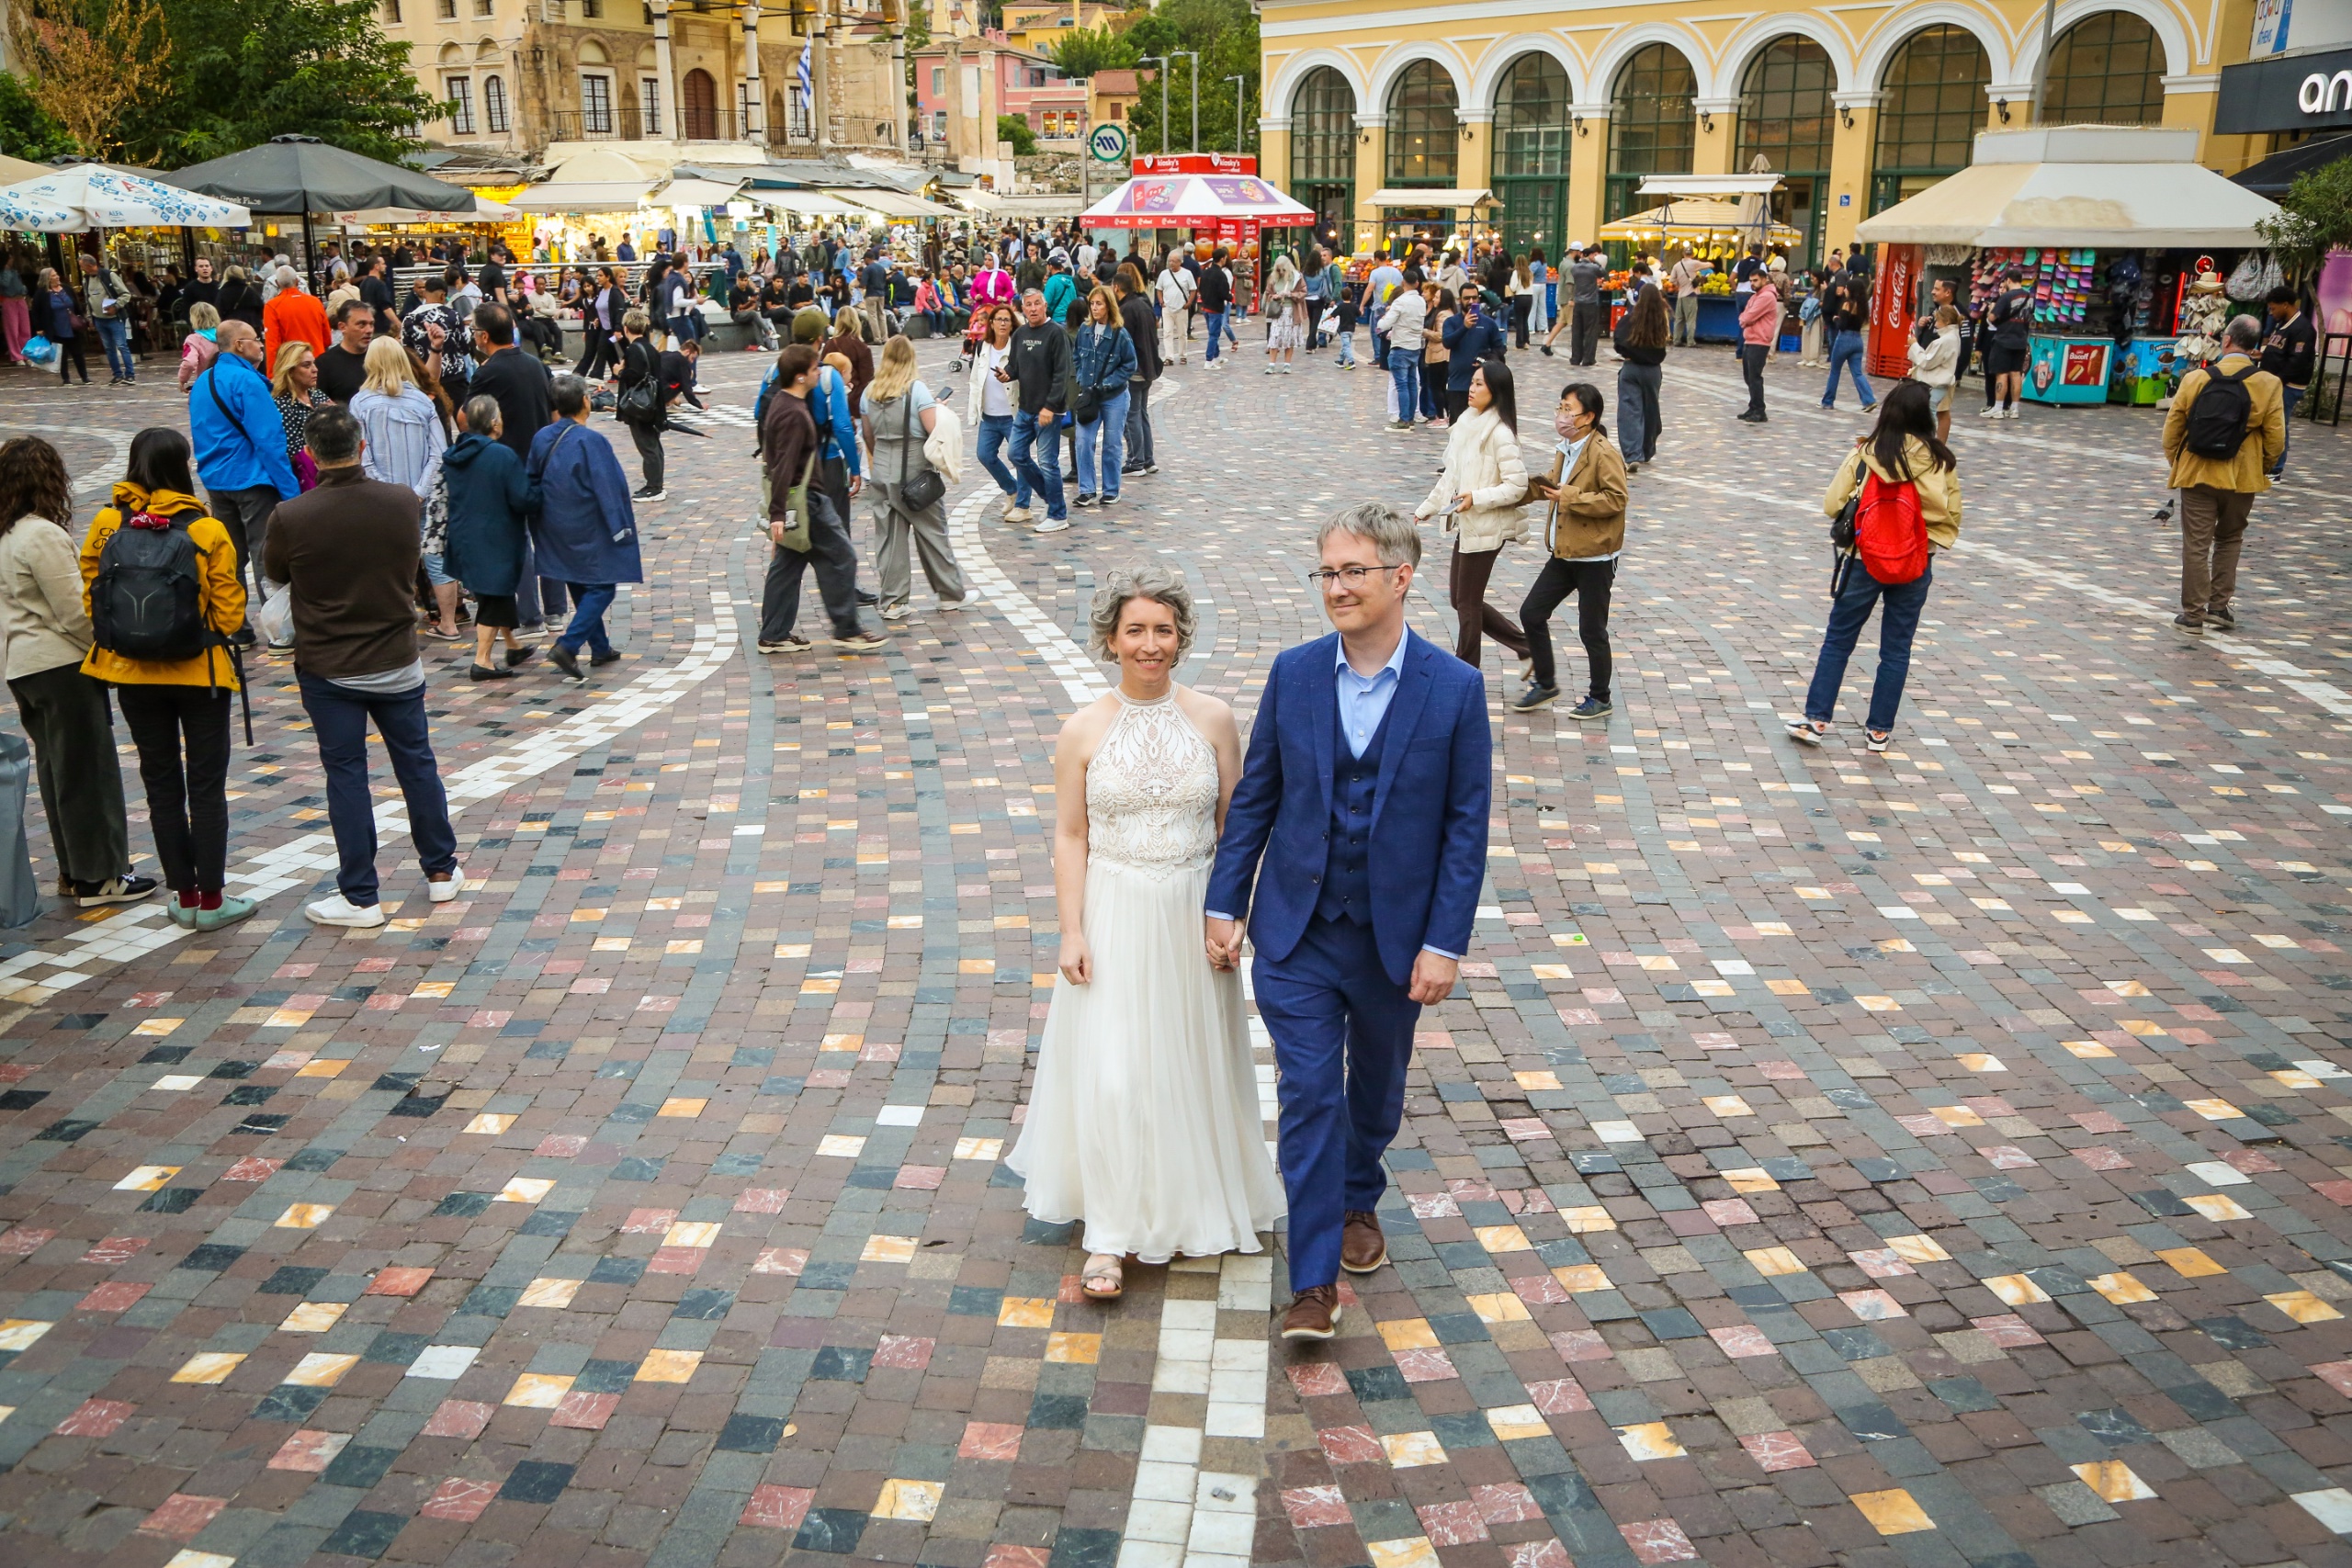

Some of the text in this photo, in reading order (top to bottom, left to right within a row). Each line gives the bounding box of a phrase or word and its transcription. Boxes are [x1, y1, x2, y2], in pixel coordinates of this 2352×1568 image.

[1157, 159, 1179, 167] kiosky's
[1219, 160, 1240, 168] kiosky's
[1889, 261, 1907, 329] Coca-Cola
